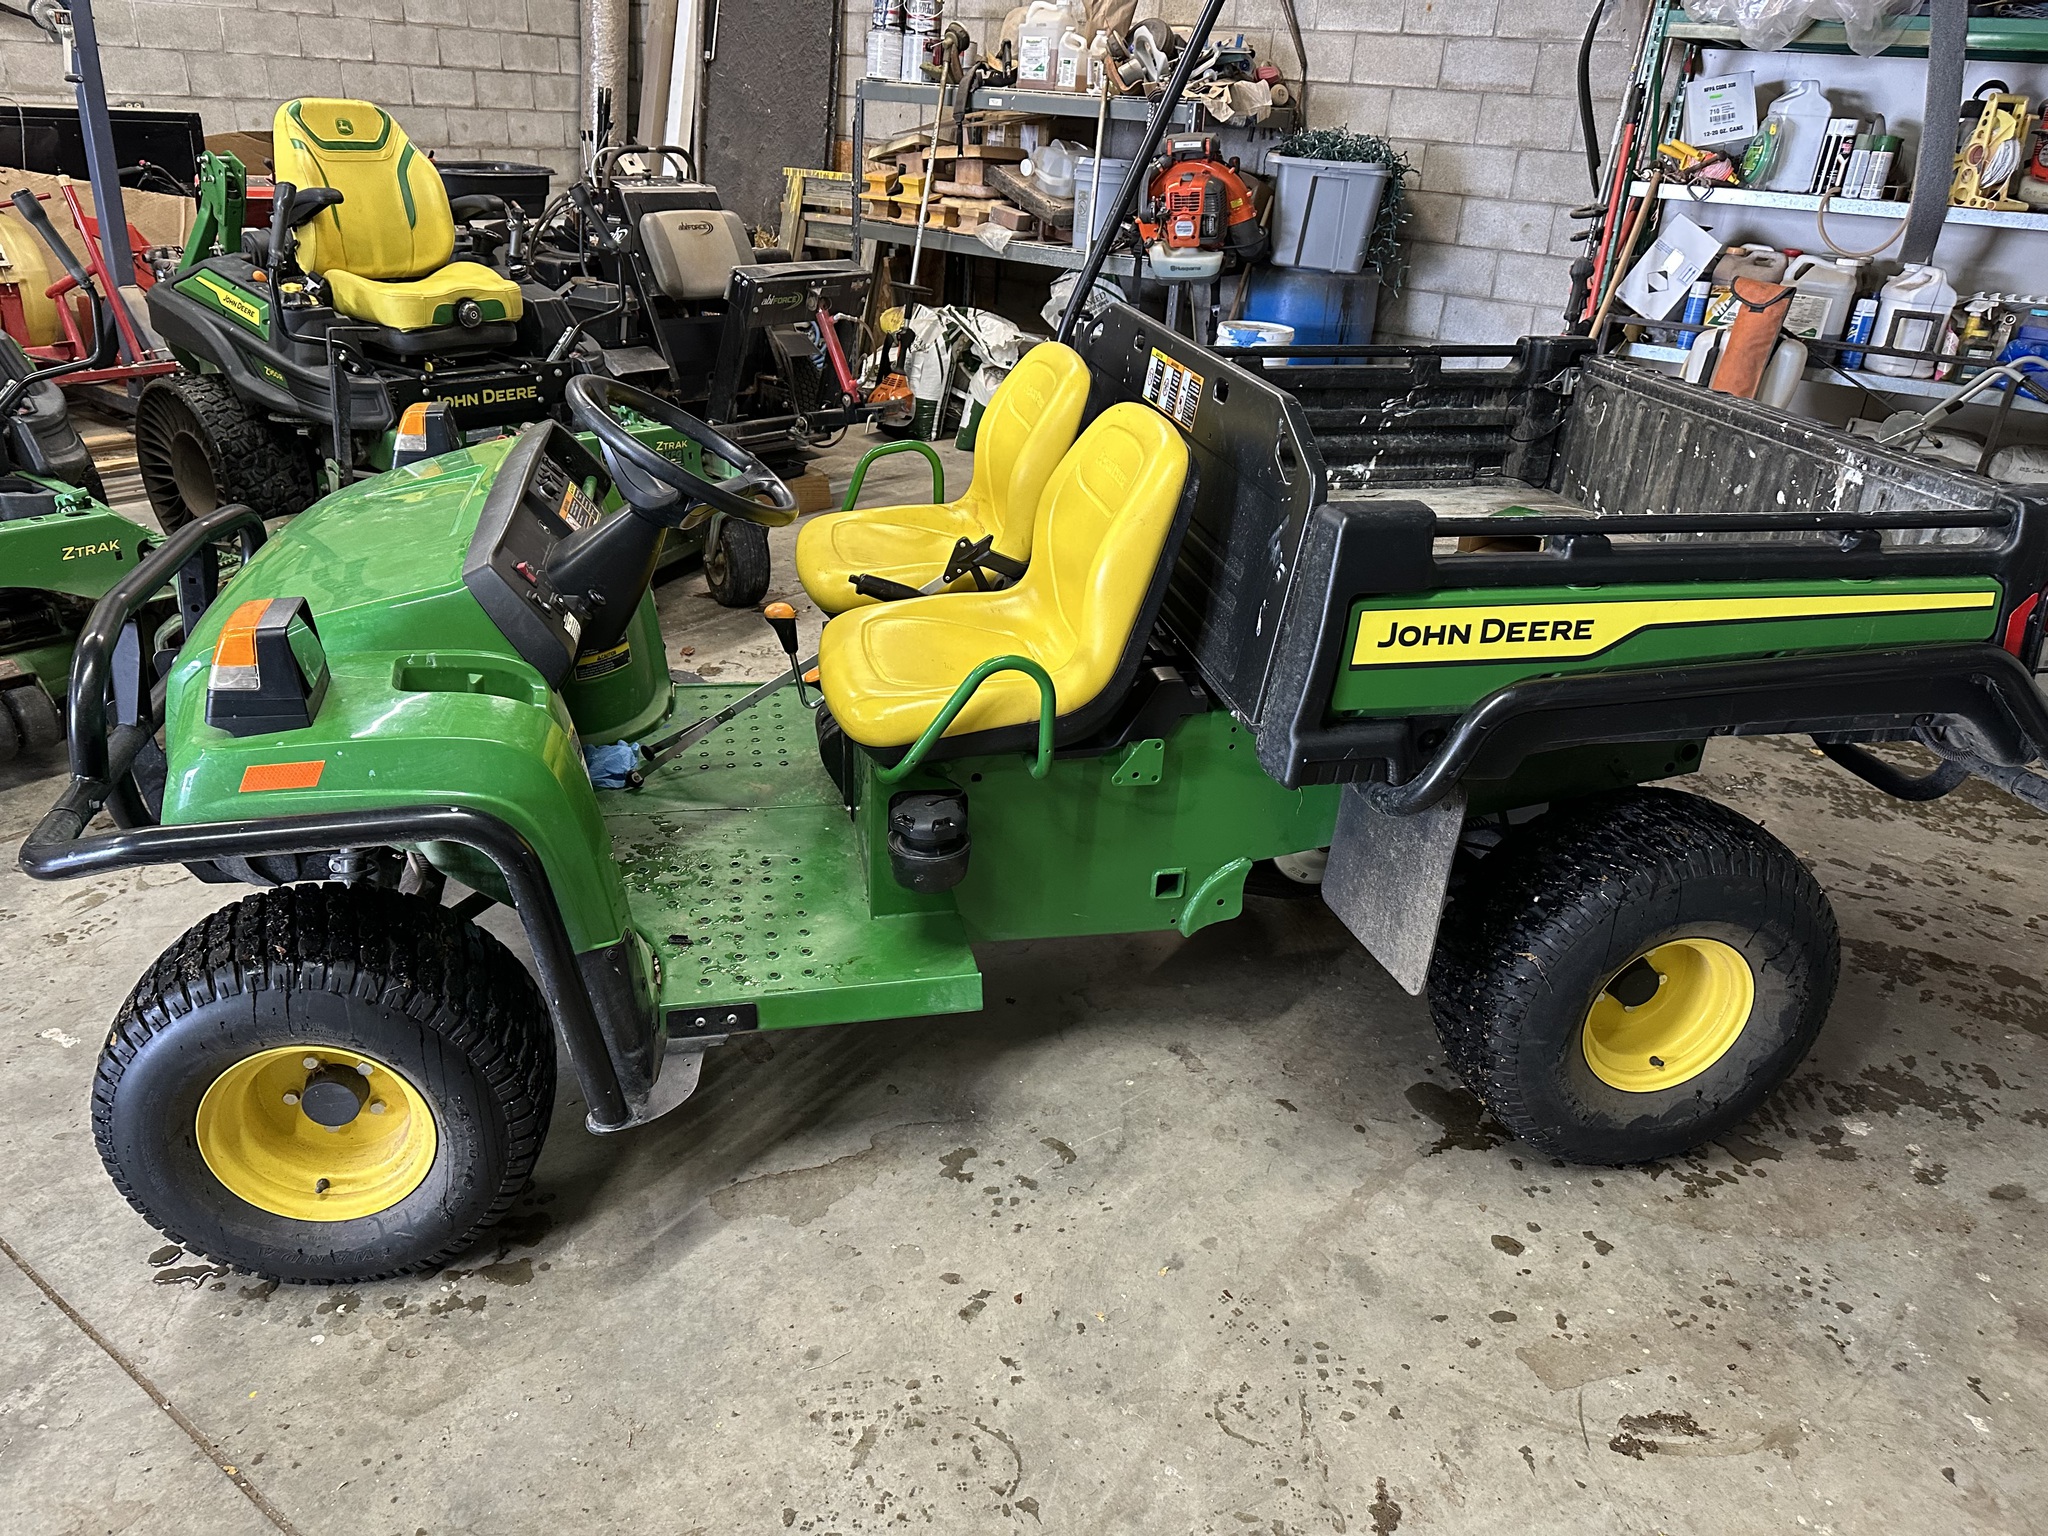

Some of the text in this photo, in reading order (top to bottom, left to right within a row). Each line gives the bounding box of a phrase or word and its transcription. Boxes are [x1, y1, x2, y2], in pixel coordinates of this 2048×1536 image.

[1716, 83, 1727, 91] CODE
[222, 294, 255, 318] JOHN DEERE
[482, 385, 538, 404] DEERE
[655, 440, 688, 451] ZTRAK
[61, 539, 121, 561] ZTRAK
[1377, 618, 1595, 648] JOHN DEERE
